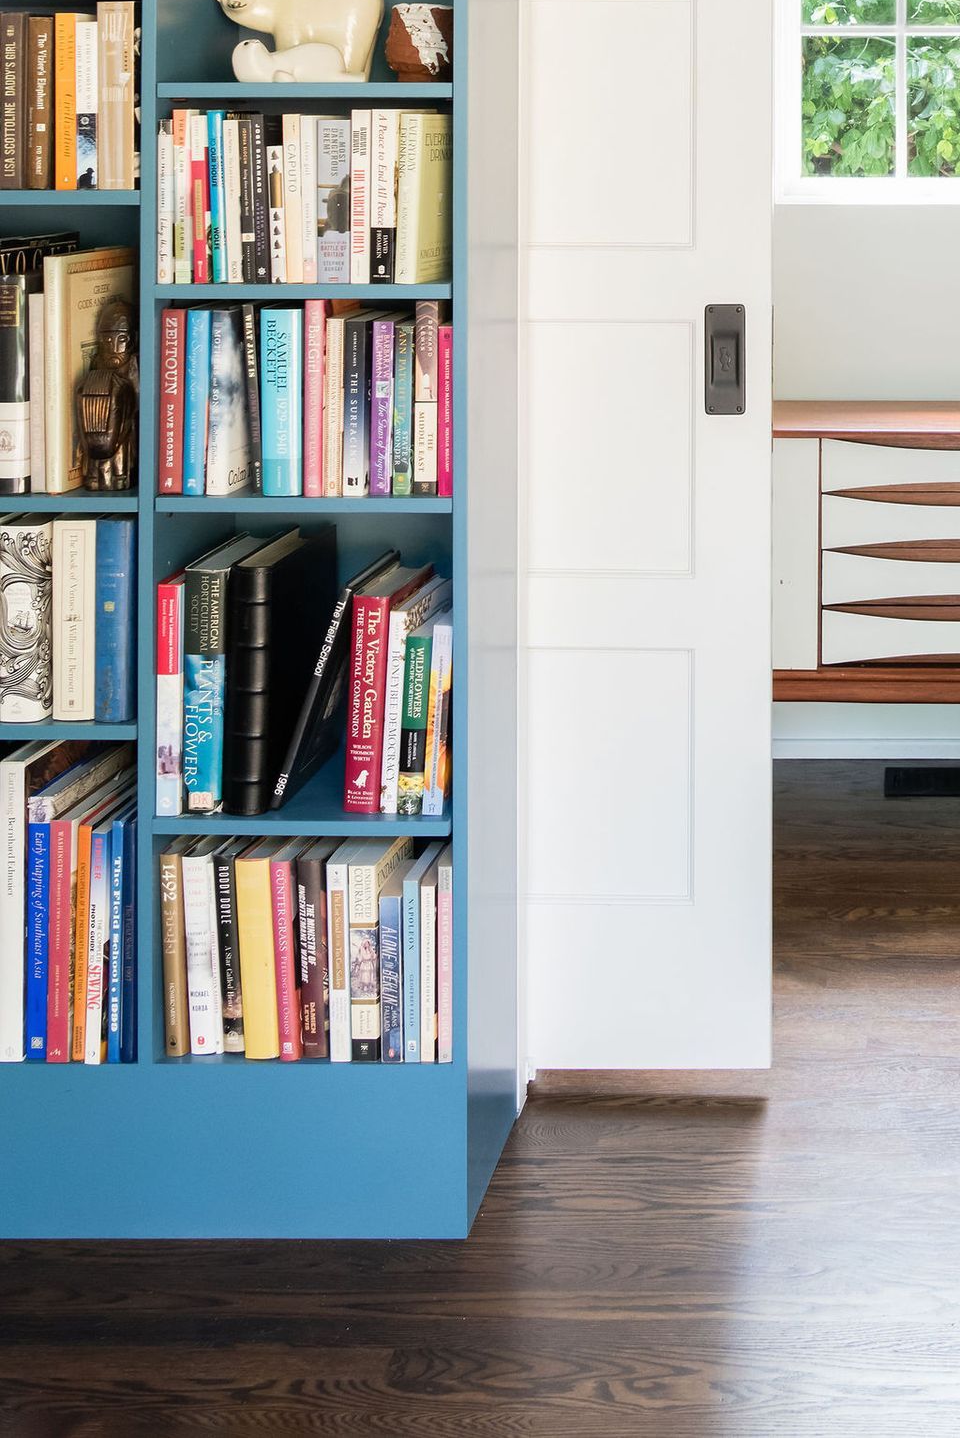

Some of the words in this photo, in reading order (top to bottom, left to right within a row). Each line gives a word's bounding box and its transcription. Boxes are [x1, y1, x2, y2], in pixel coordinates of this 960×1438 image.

[5, 42, 15, 59] GIRL
[38, 33, 46, 48] The
[37, 50, 46, 75] Vizier's
[5, 62, 15, 96] DADDY'S
[36, 78, 45, 110] Elephant
[5, 103, 15, 154] SCOTTOLINE
[377, 125, 386, 149] Peace
[5, 158, 15, 176] LISA
[287, 144, 296, 192] CAPUTO
[378, 152, 386, 161] to
[377, 164, 387, 182] End
[377, 186, 386, 198] All
[377, 202, 386, 226] Peace
[165, 317, 178, 394] ZEITOUN
[267, 320, 277, 385] BECKETT
[276, 332, 288, 392] SAMUEL
[211, 579, 219, 597] THE
[191, 595, 199, 633] SOCIETY
[200, 576, 209, 652] HORTICULTURAL
[210, 599, 219, 649] AMERICAN
[332, 601, 346, 618] The
[367, 608, 380, 634] The
[325, 619, 340, 642] Field
[314, 644, 331, 676] School
[365, 640, 378, 685] Victory
[199, 660, 214, 723] PLANTS
[414, 648, 425, 718] WILDFLOWERS
[363, 690, 376, 738] Garden
[185, 705, 198, 785] FLOWERS
[199, 731, 212, 743] &
[274, 772, 289, 796] 1996
[34, 832, 45, 855] Early
[32, 859, 45, 897] Mapping
[163, 864, 176, 902] 1492
[218, 866, 229, 894] RODDY
[33, 900, 45, 909] of
[220, 898, 231, 924] DOYLE
[34, 912, 44, 955] Southeast
[381, 926, 397, 960] ALONE
[35, 958, 43, 978] Asia
[87, 965, 100, 1009] SEWING
[382, 969, 398, 1004] BERLIN
